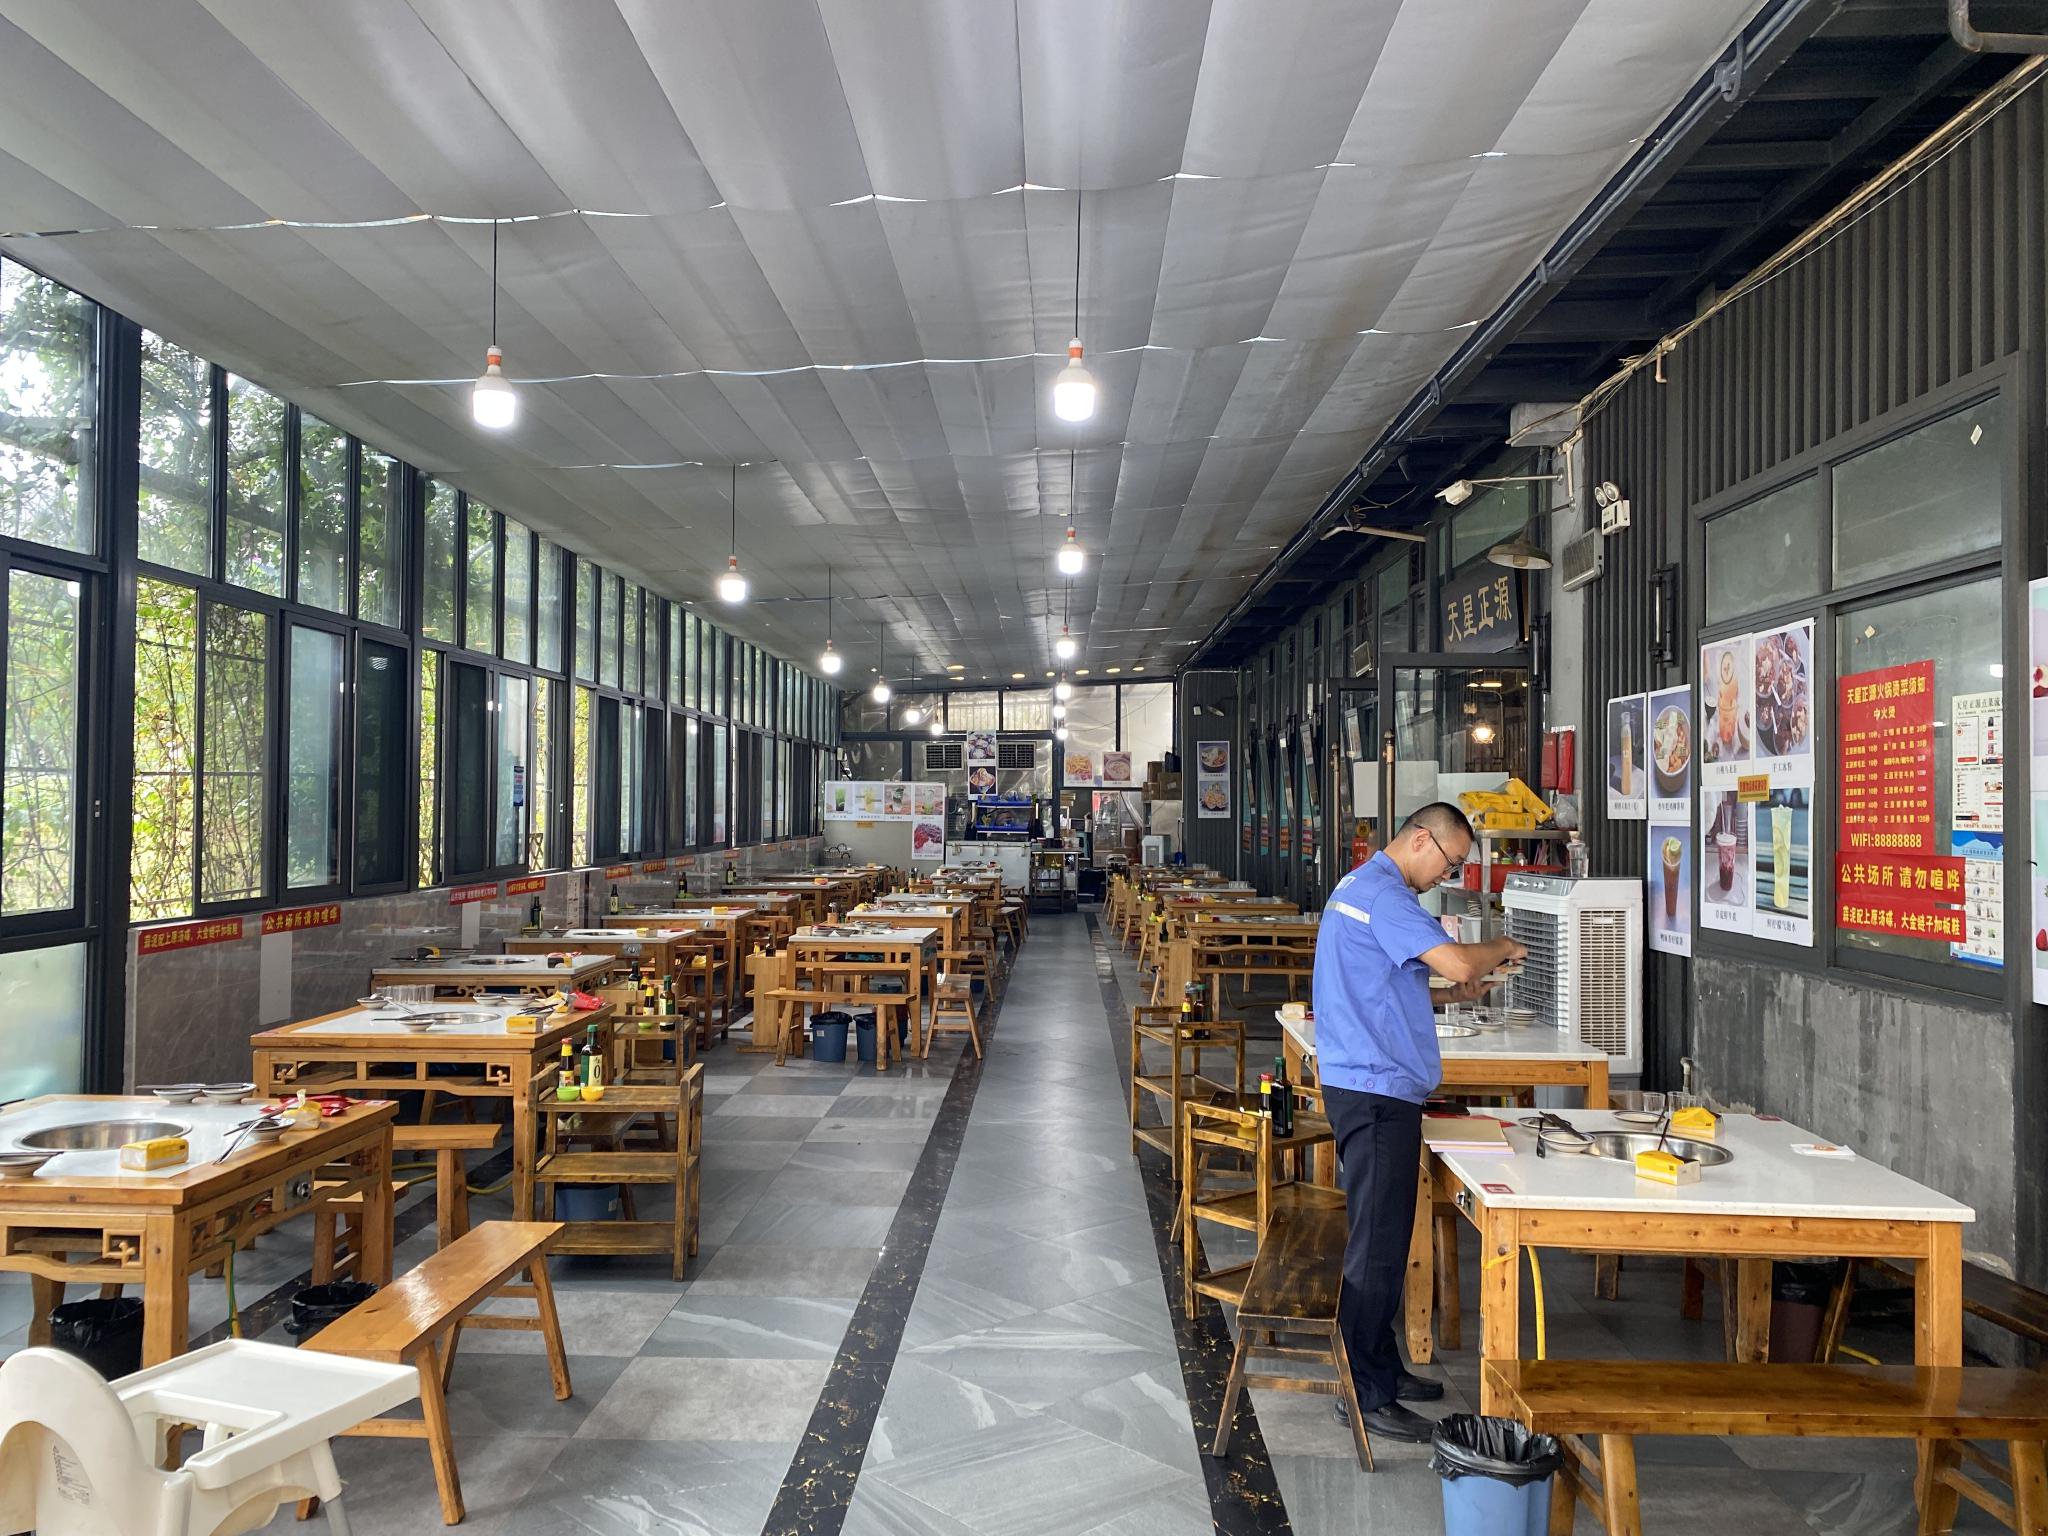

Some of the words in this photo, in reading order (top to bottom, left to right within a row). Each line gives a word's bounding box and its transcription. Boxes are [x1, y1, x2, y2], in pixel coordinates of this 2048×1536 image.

[1448, 576, 1512, 641] 天星正源
[1851, 833, 1922, 848] WIFI:88888888
